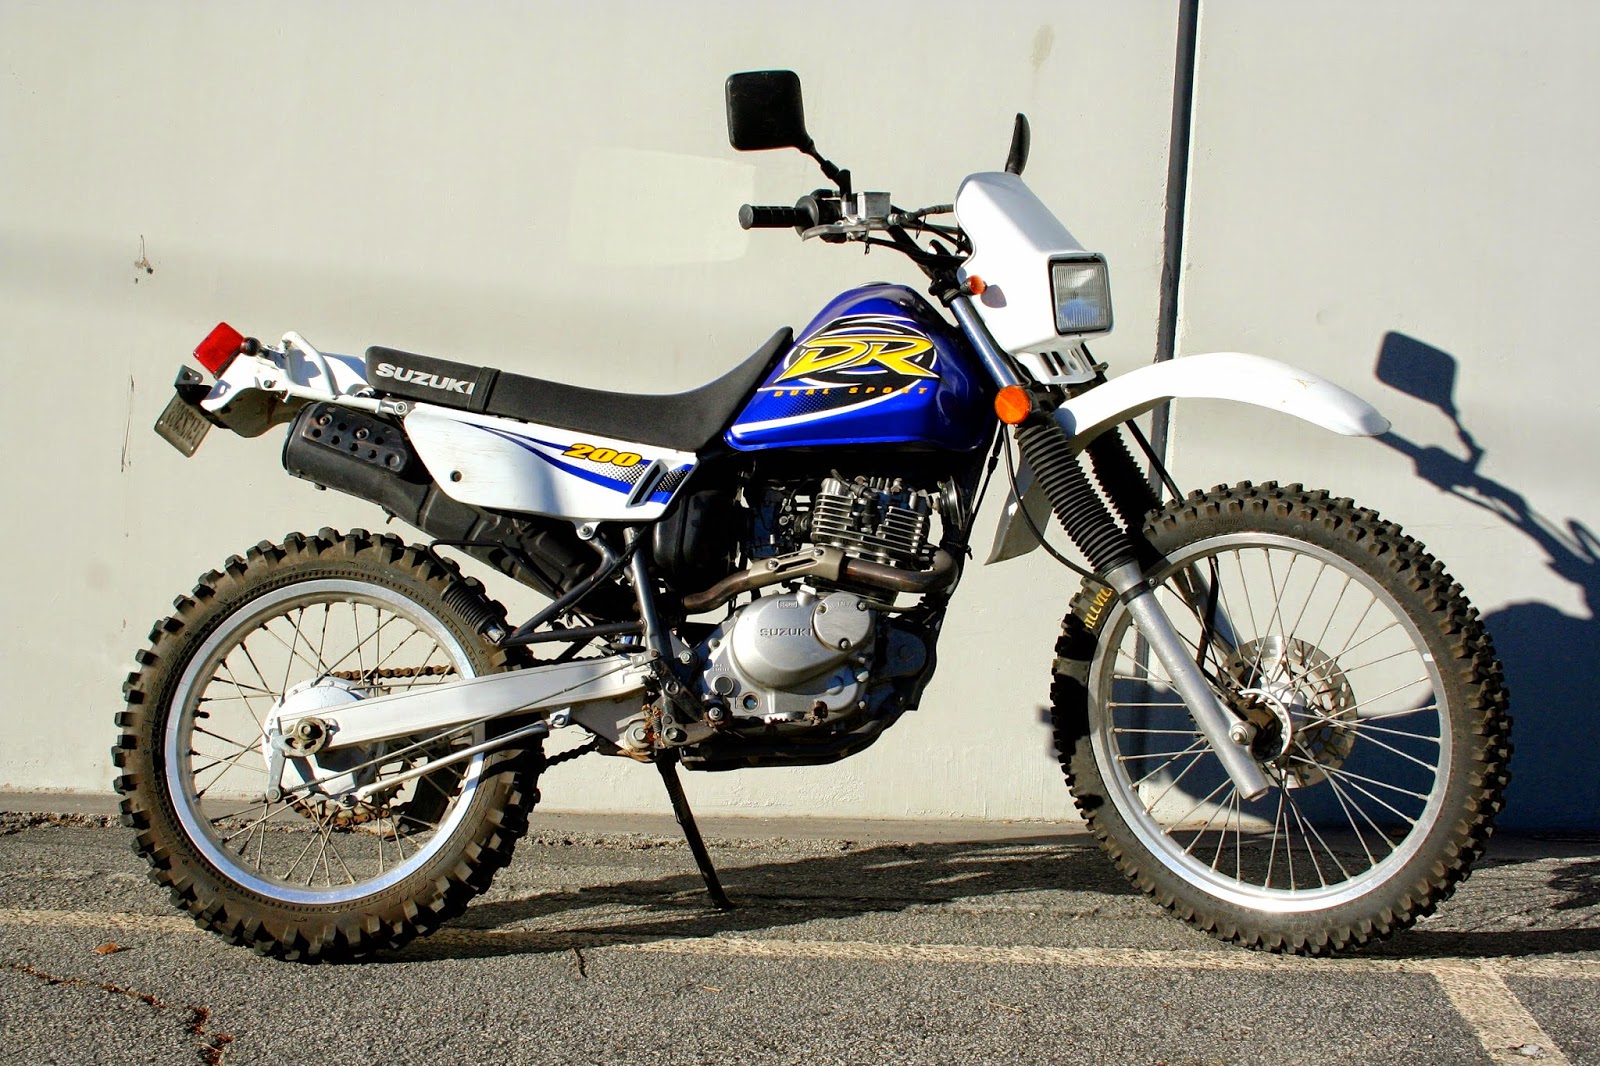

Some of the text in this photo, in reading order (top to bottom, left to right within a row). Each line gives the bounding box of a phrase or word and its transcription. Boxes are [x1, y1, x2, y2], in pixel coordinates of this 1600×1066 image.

[773, 334, 940, 383] DR
[375, 362, 475, 395] SUZUKI
[773, 387, 831, 397] DUAL
[561, 443, 642, 467] 200
[1084, 587, 1114, 629] ILLVIL
[759, 627, 813, 637] SUZUKI
